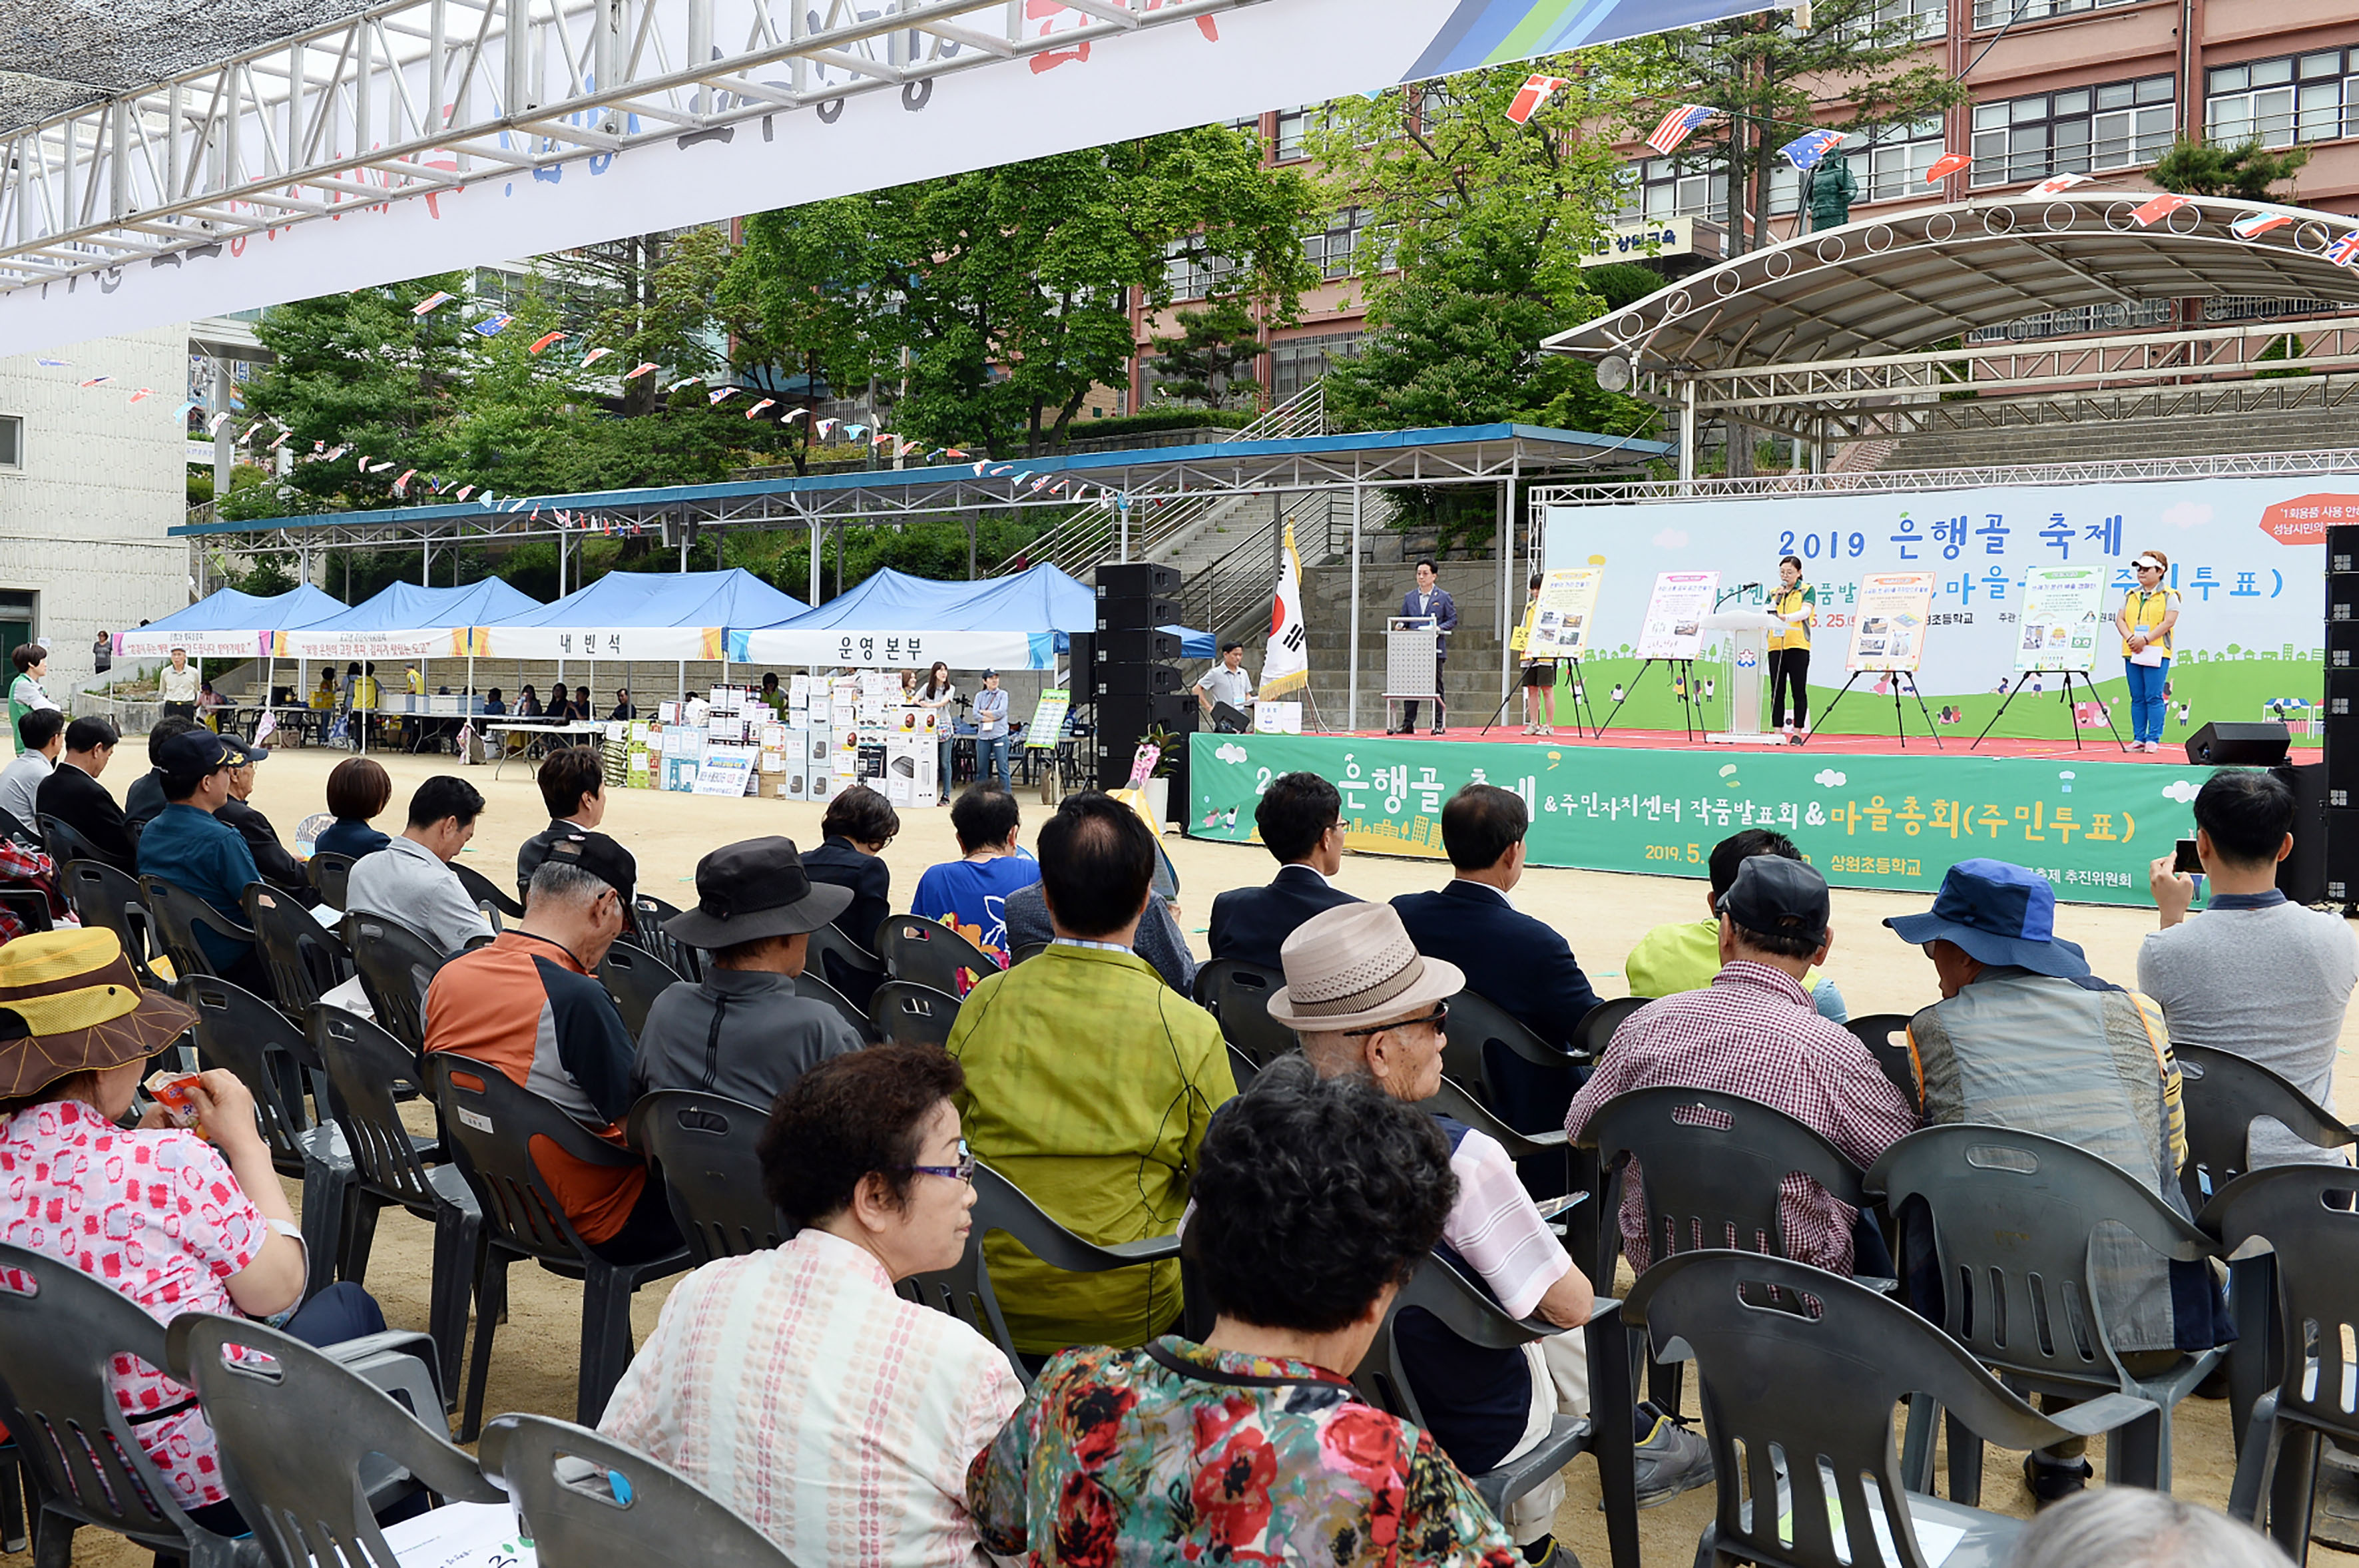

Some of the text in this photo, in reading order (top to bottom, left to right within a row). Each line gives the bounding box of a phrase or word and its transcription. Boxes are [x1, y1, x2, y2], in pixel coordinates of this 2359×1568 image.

[2322, 506, 2343, 518] 사용
[1778, 512, 2123, 560] 2019 은행골 축제
[2273, 522, 2324, 535] 성남시민의
[1338, 759, 1445, 814] 은행골
[1645, 845, 1683, 862] 2019.
[1831, 854, 1922, 877] 상원초등학교
[2065, 870, 2132, 888] 추진위원회
